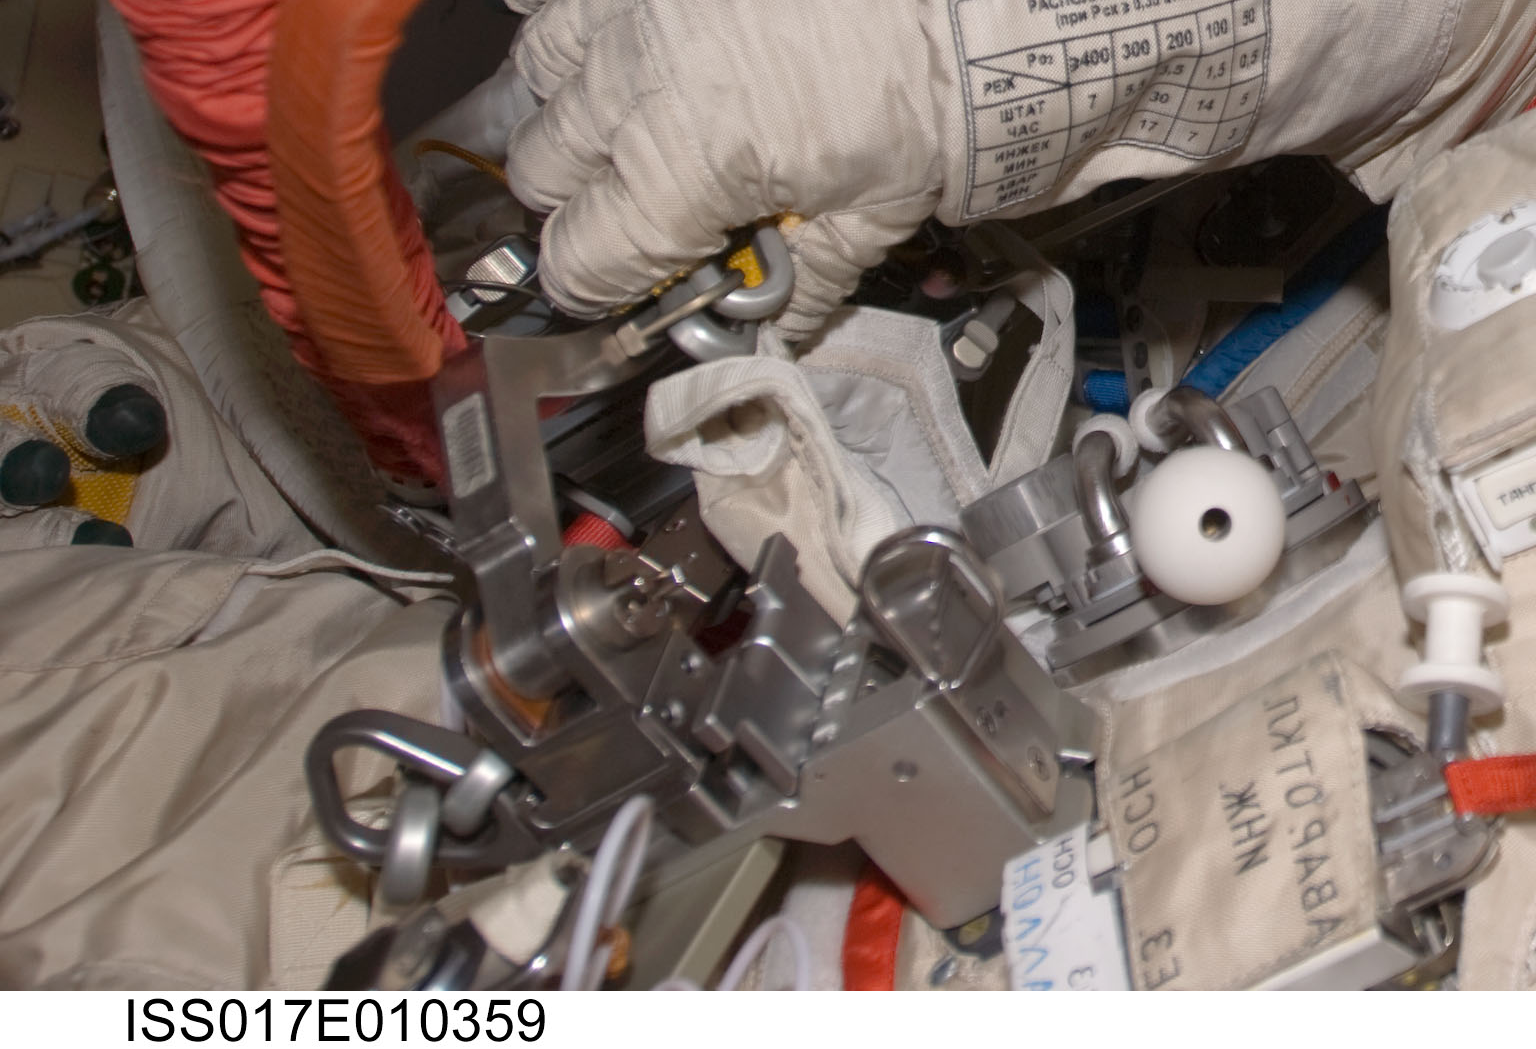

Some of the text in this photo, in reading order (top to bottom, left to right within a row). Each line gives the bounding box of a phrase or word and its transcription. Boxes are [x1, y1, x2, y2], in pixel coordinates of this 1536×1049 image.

[1122, 39, 1151, 60] 300
[1166, 29, 1194, 51] 200
[1206, 18, 1228, 40] 100
[1242, 8, 1256, 27] 50
[983, 75, 1016, 97] РЕЖ
[1001, 99, 1046, 124] ШТАТ
[1088, 93, 1097, 110] 7
[1206, 61, 1226, 81] 1,5
[1150, 91, 1170, 104] 30
[1196, 100, 1214, 112] 14
[1007, 120, 1040, 139] ЧАС
[1140, 119, 1159, 132] 17
[1188, 130, 1199, 142] 7
[1003, 157, 1038, 176] МИН
